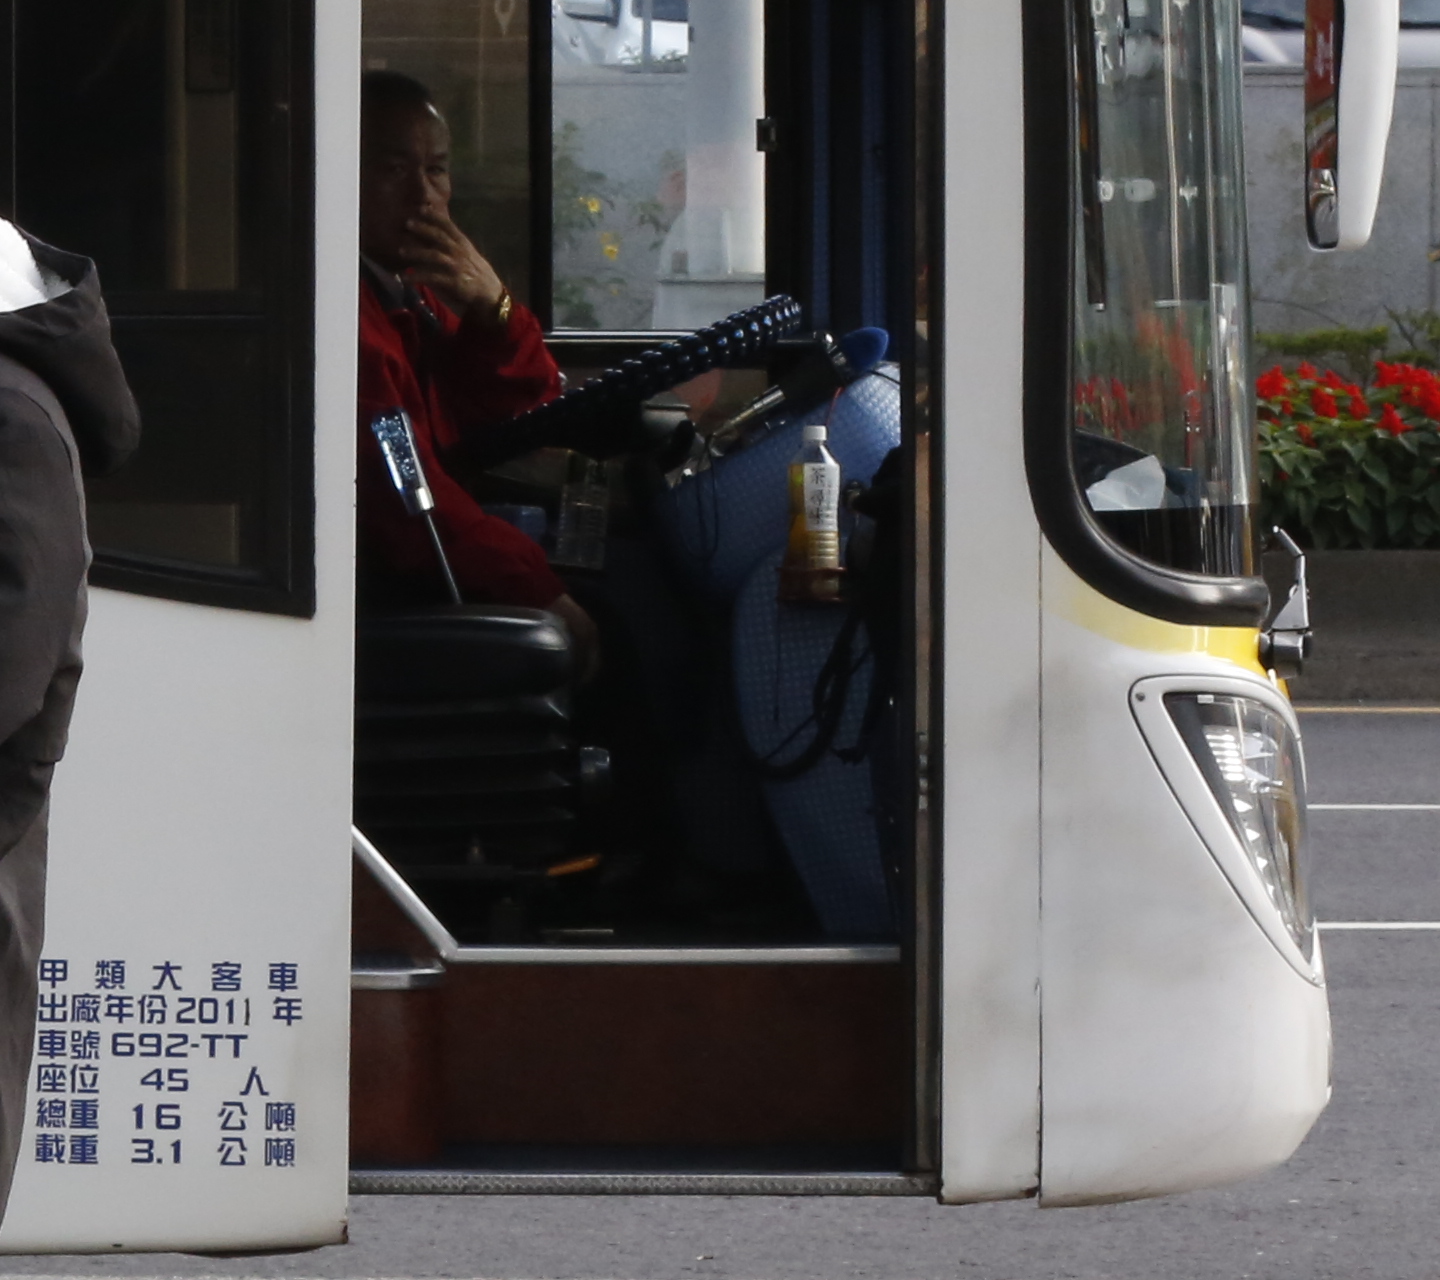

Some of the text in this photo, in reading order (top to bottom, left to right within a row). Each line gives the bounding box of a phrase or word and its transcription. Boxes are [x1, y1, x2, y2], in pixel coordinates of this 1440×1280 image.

[111, 1032, 249, 1059] 692-TT
[36, 1063, 269, 1096] 座位 45 人
[132, 1104, 182, 1130] 16
[131, 1138, 182, 1164] 3.1
